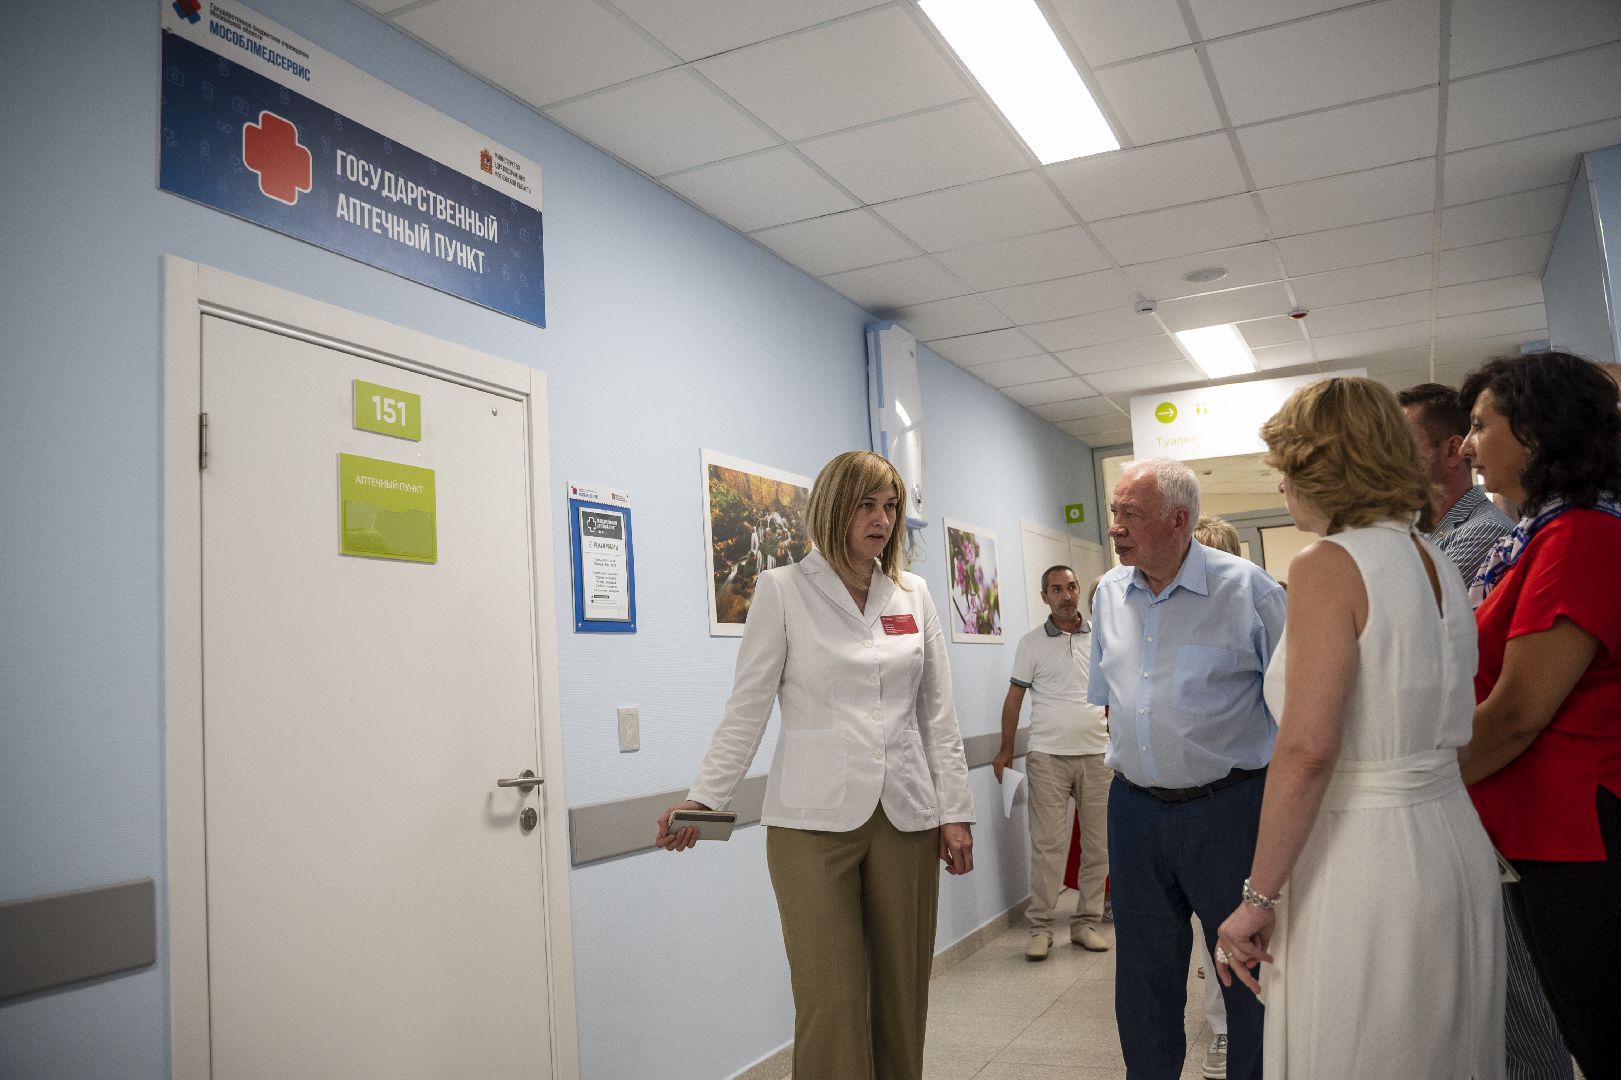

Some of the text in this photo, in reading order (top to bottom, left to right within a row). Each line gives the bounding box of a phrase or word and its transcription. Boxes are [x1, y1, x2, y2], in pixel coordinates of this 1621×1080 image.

[209, 20, 311, 82] МОСОБЛМЕДСЕРВИС
[336, 149, 498, 244] ГОСУДАРСТВЕННЫЙ
[336, 192, 485, 275] АПТЕЧНЫЙ ПУНКТ
[371, 395, 406, 427] 151
[1156, 435, 1196, 449] Туалет
[355, 474, 424, 494] АПТЕЧНЫЙ ПУНКТ
